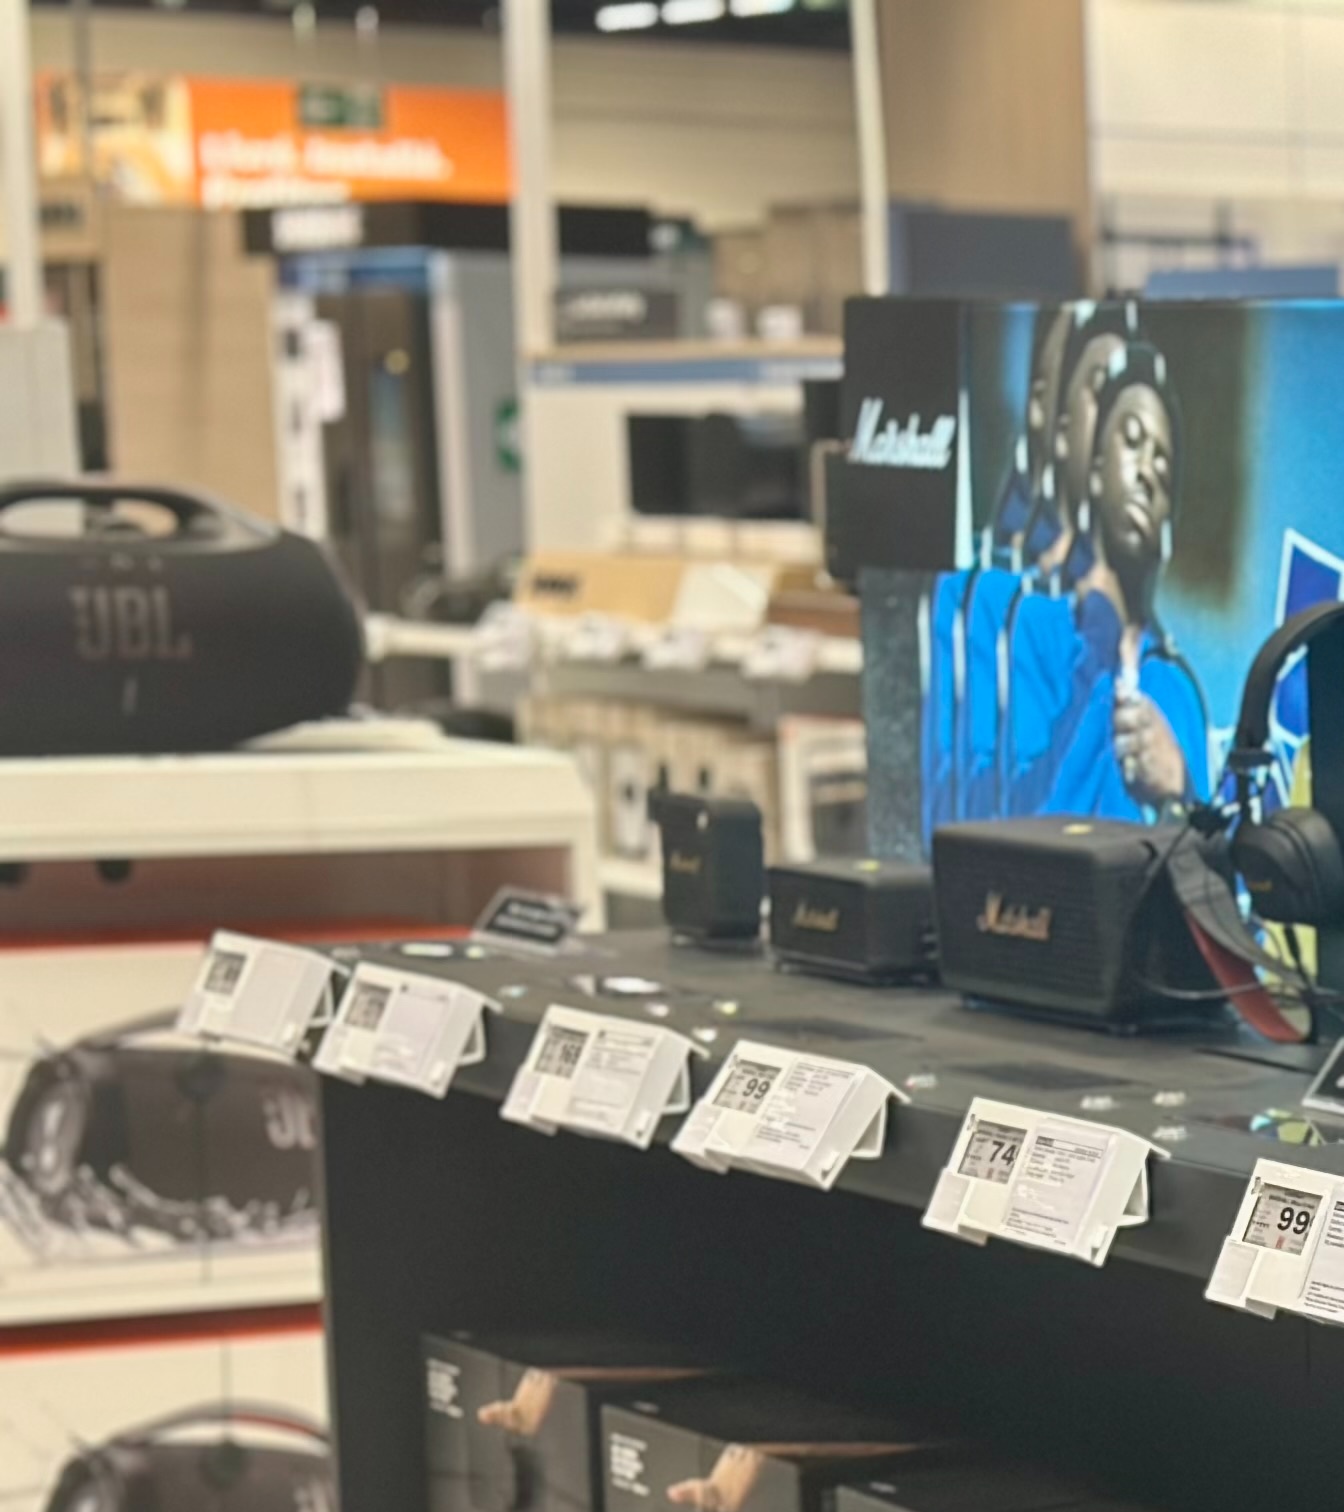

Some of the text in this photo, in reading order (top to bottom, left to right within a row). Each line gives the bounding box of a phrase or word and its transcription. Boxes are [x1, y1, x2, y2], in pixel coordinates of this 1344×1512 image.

[847, 397, 956, 469] Marshall
[70, 585, 192, 661] JBL
[990, 1140, 1017, 1166] 74
[1277, 1207, 1311, 1235] 99
